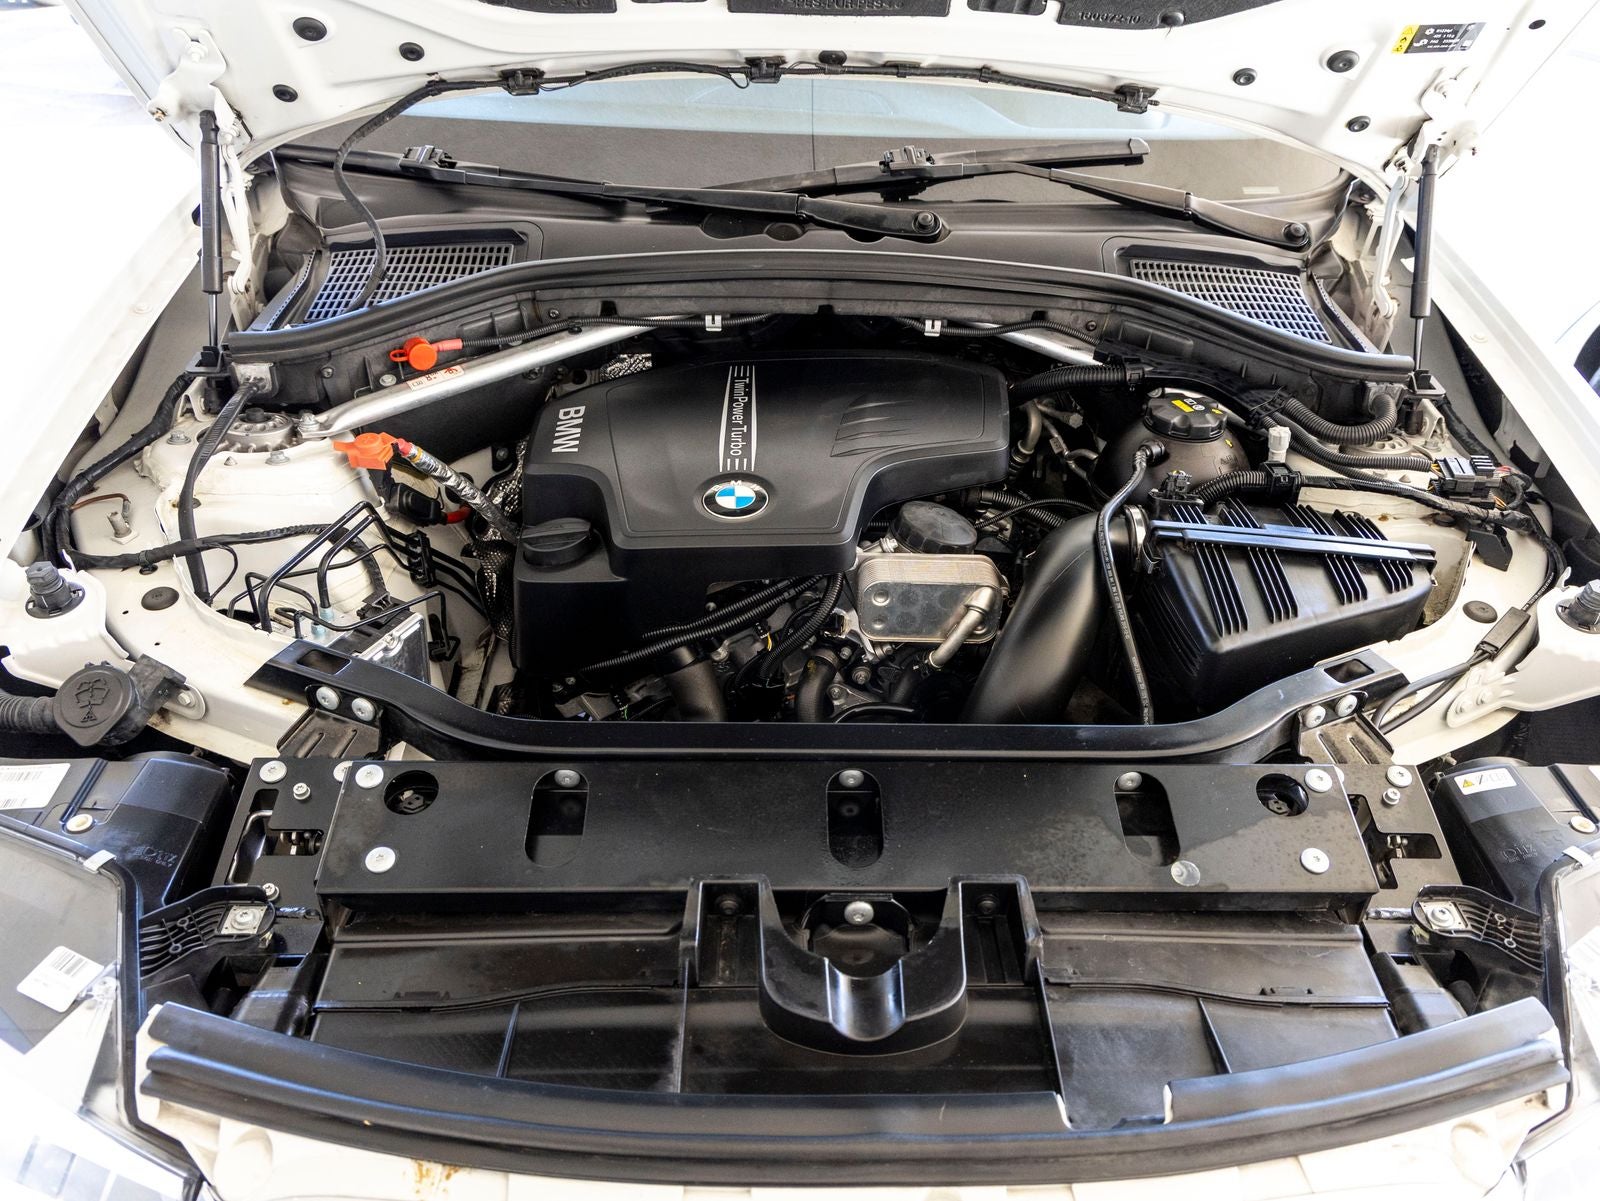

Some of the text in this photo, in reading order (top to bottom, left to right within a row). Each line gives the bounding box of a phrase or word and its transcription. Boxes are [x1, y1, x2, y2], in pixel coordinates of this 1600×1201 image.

[552, 405, 586, 452] BMW
[730, 378, 749, 456] TwinPower Turbo
